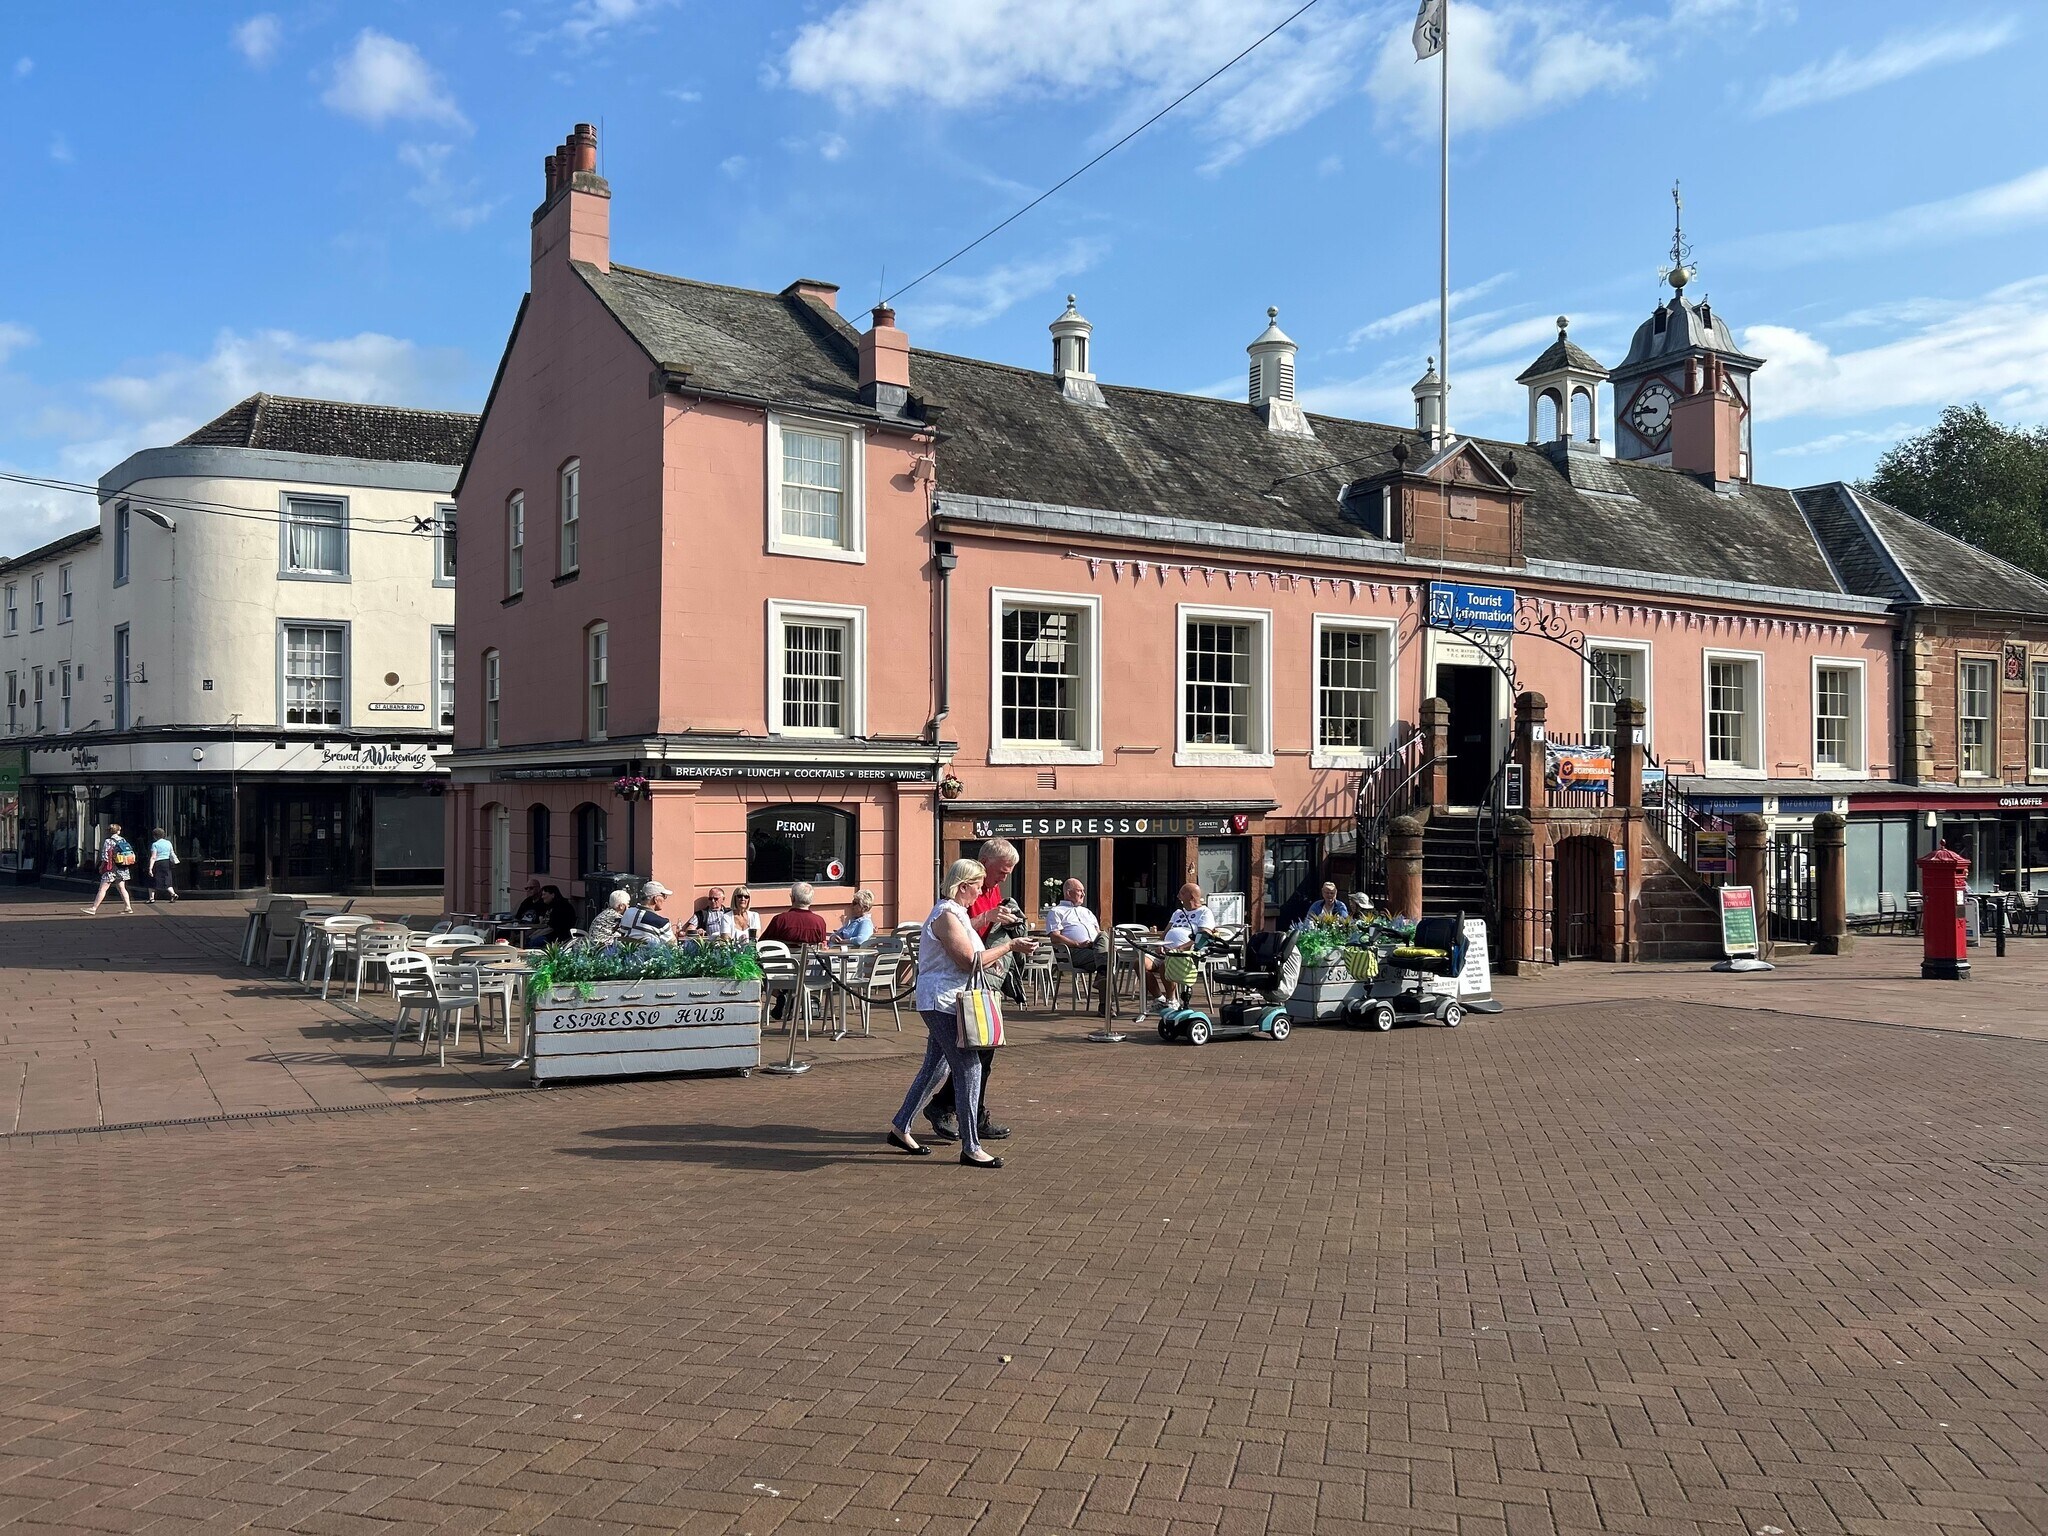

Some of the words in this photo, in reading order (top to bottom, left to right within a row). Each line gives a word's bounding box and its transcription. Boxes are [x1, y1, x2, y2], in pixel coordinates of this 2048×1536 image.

[1467, 592, 1502, 607] Tourist
[1455, 606, 1513, 623] Information
[322, 749, 359, 763] Brewed
[675, 768, 733, 777] BREAKFAST
[747, 769, 781, 778] LUNCH
[794, 769, 845, 778] COCKTAILS
[858, 770, 886, 779] BEERS
[897, 771, 926, 780] WINES
[2000, 798, 2018, 806] COSTA
[2020, 798, 2042, 806] COFFEE
[776, 820, 815, 832] PERONI
[553, 1010, 660, 1030] ESPRESSO
[674, 1006, 725, 1024] HUB
